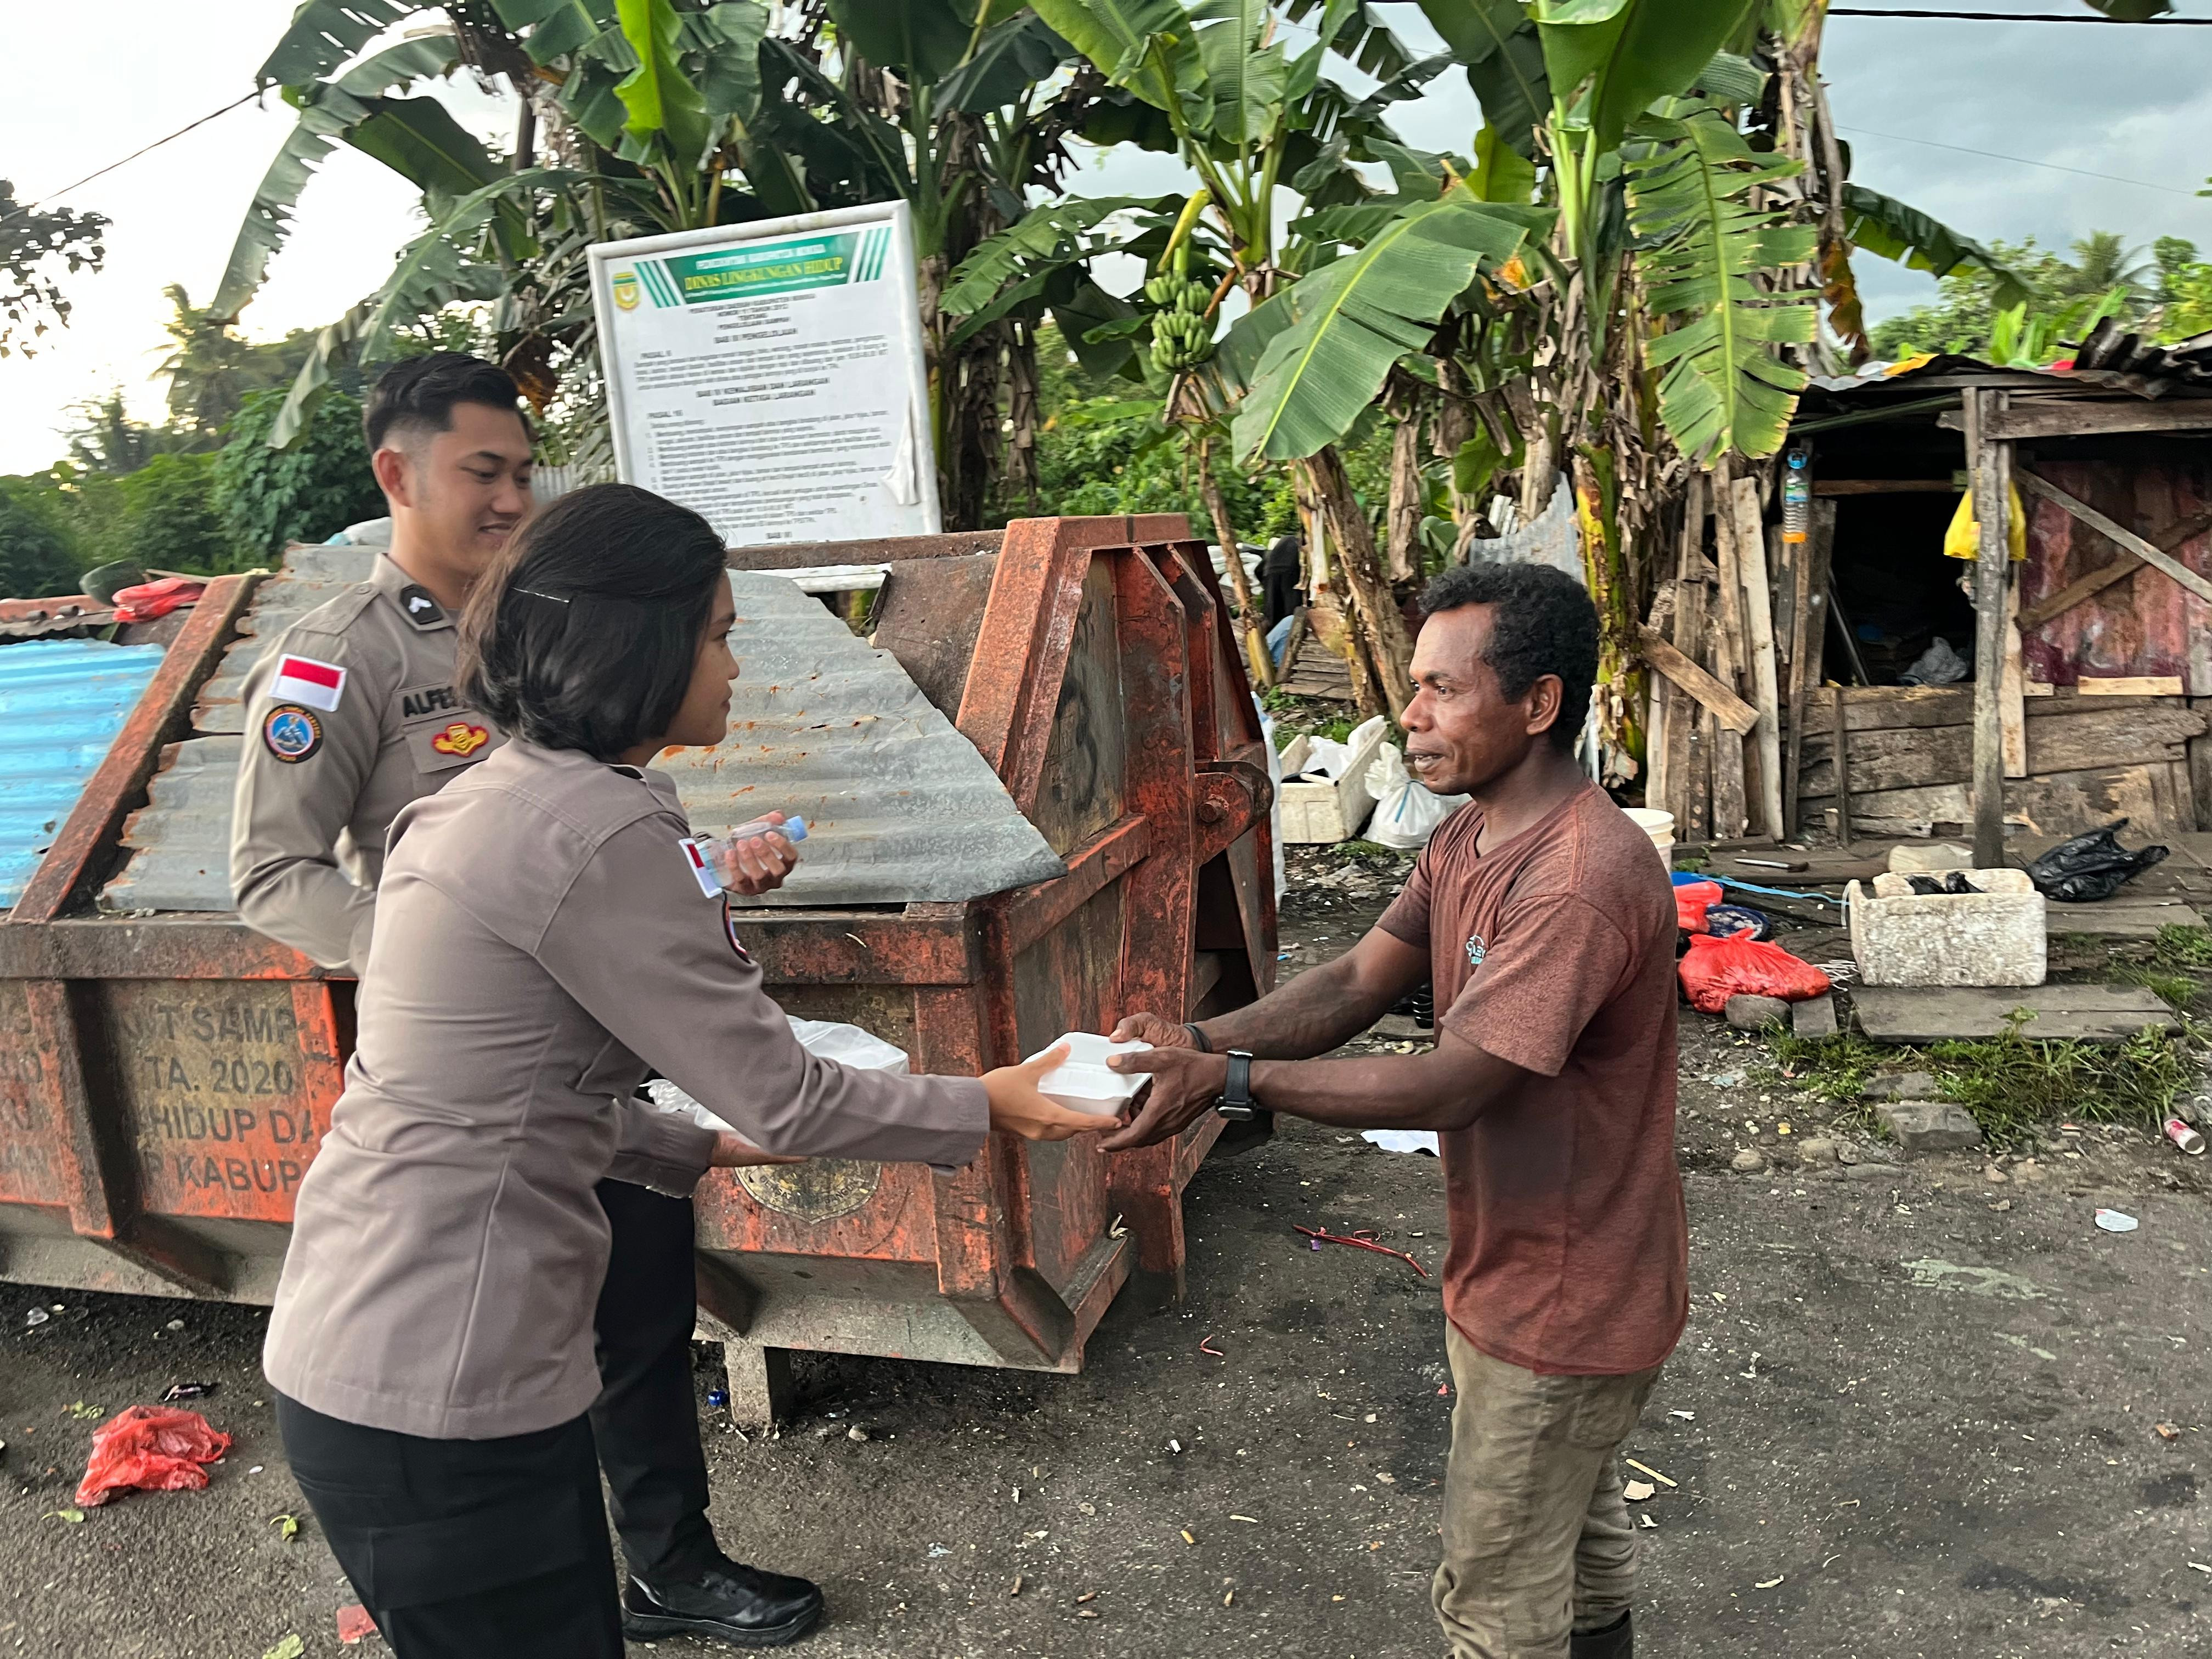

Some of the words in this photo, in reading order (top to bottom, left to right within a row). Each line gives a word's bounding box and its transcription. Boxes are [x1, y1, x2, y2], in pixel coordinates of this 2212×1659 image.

[804, 257, 843, 274] HIDUP
[210, 1059, 293, 1094] 2020
[149, 1104, 256, 1143] HIDUP
[175, 1154, 302, 1193] KABUP
